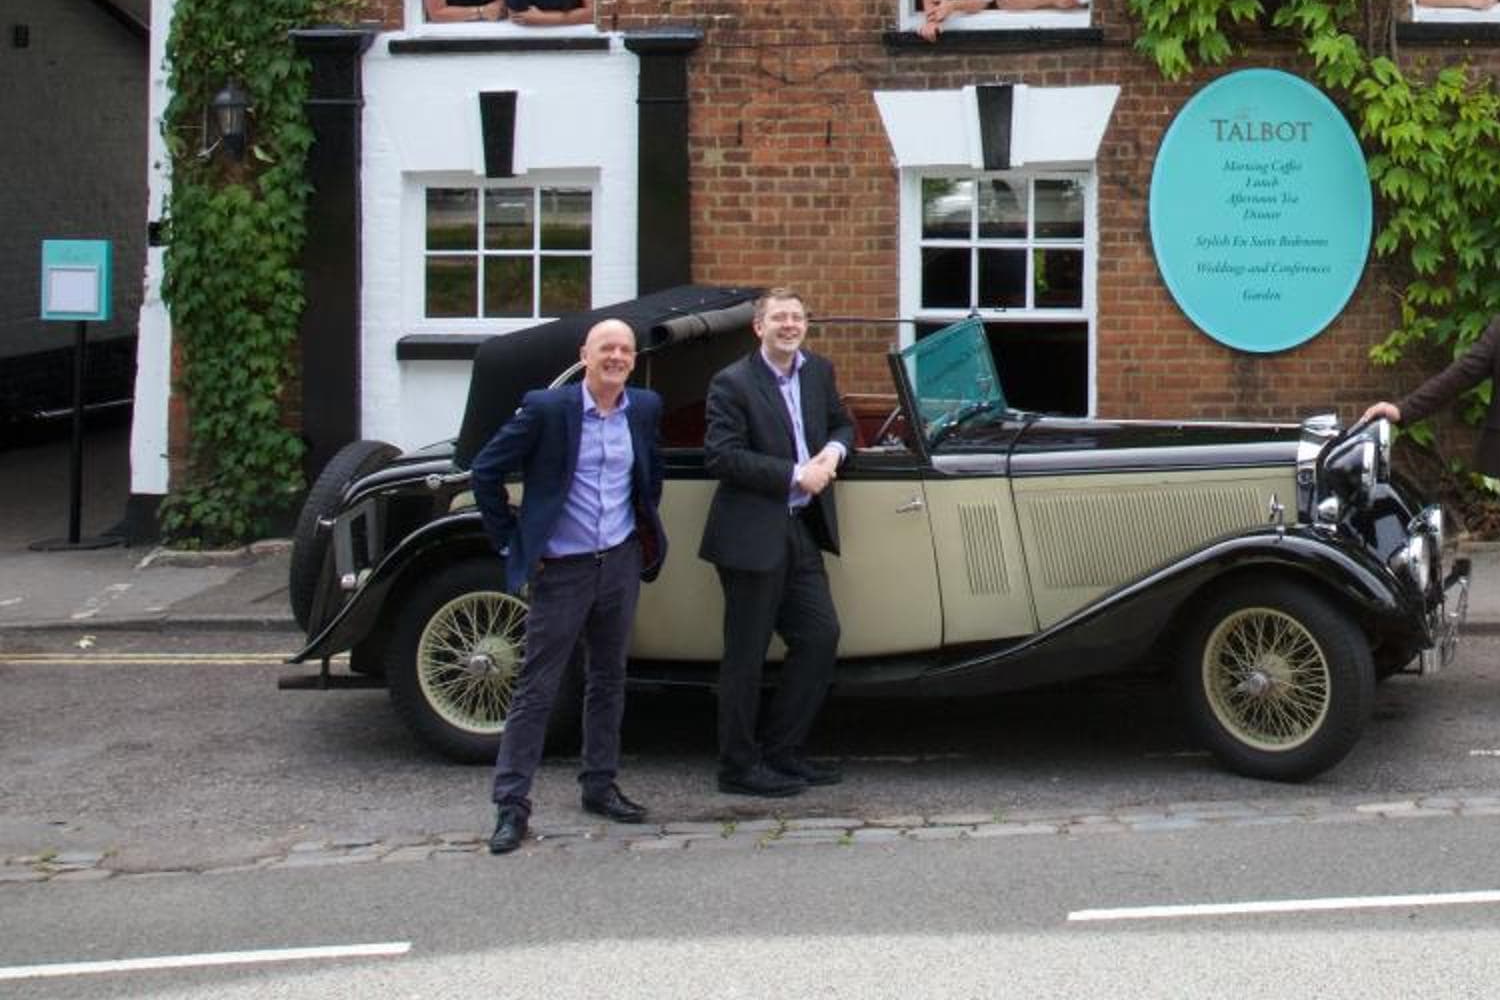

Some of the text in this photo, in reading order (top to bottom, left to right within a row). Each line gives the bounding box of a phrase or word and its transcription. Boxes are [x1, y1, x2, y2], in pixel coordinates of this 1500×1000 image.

[1210, 119, 1312, 142] TALBOT
[1223, 159, 1302, 175] Morning Coffee
[1245, 176, 1279, 188] Lunch
[1225, 192, 1299, 207] Afternoon Tea
[1243, 208, 1281, 219] Dinner
[1196, 234, 1329, 249] Stylish En Suite Bedrooms
[1197, 261, 1331, 275] Weddings and Conferences
[1242, 288, 1281, 301] Garden
